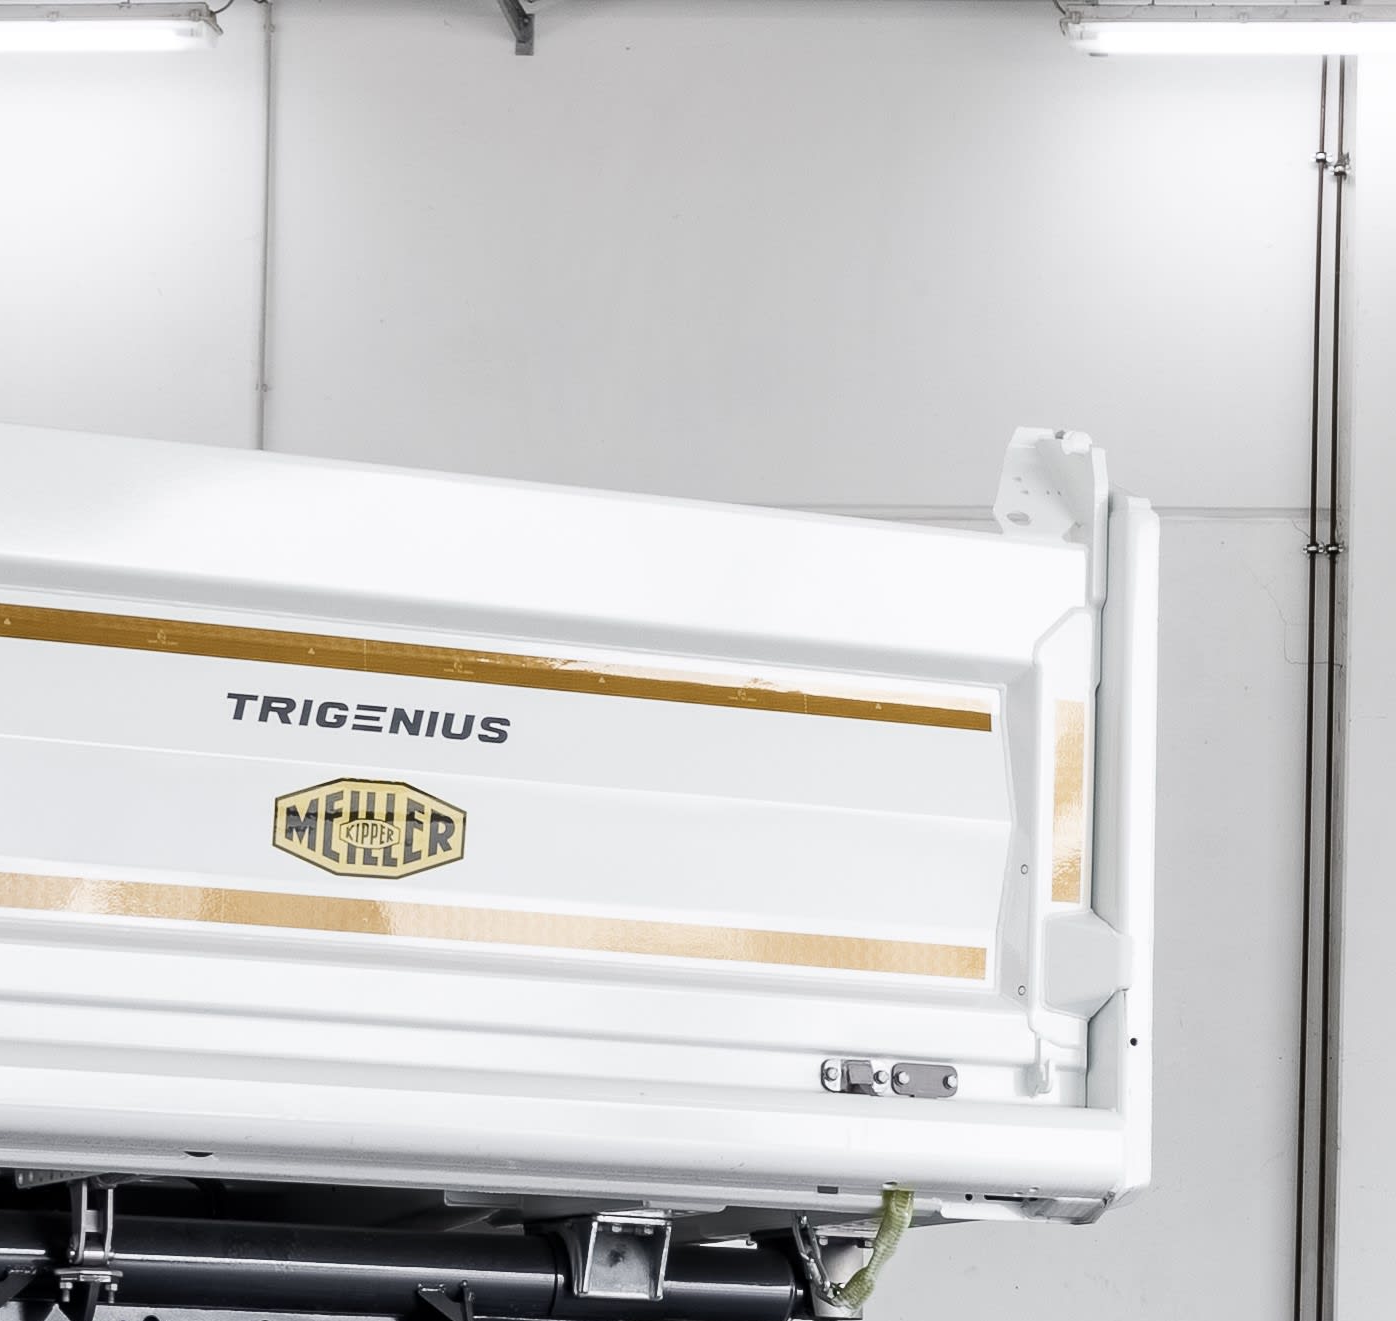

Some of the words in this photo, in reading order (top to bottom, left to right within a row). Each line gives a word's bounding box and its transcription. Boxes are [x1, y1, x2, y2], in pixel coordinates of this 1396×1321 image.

[226, 692, 512, 744] TRIGENIUS
[284, 789, 456, 868] MEILLER
[345, 821, 395, 846] KIPPER
